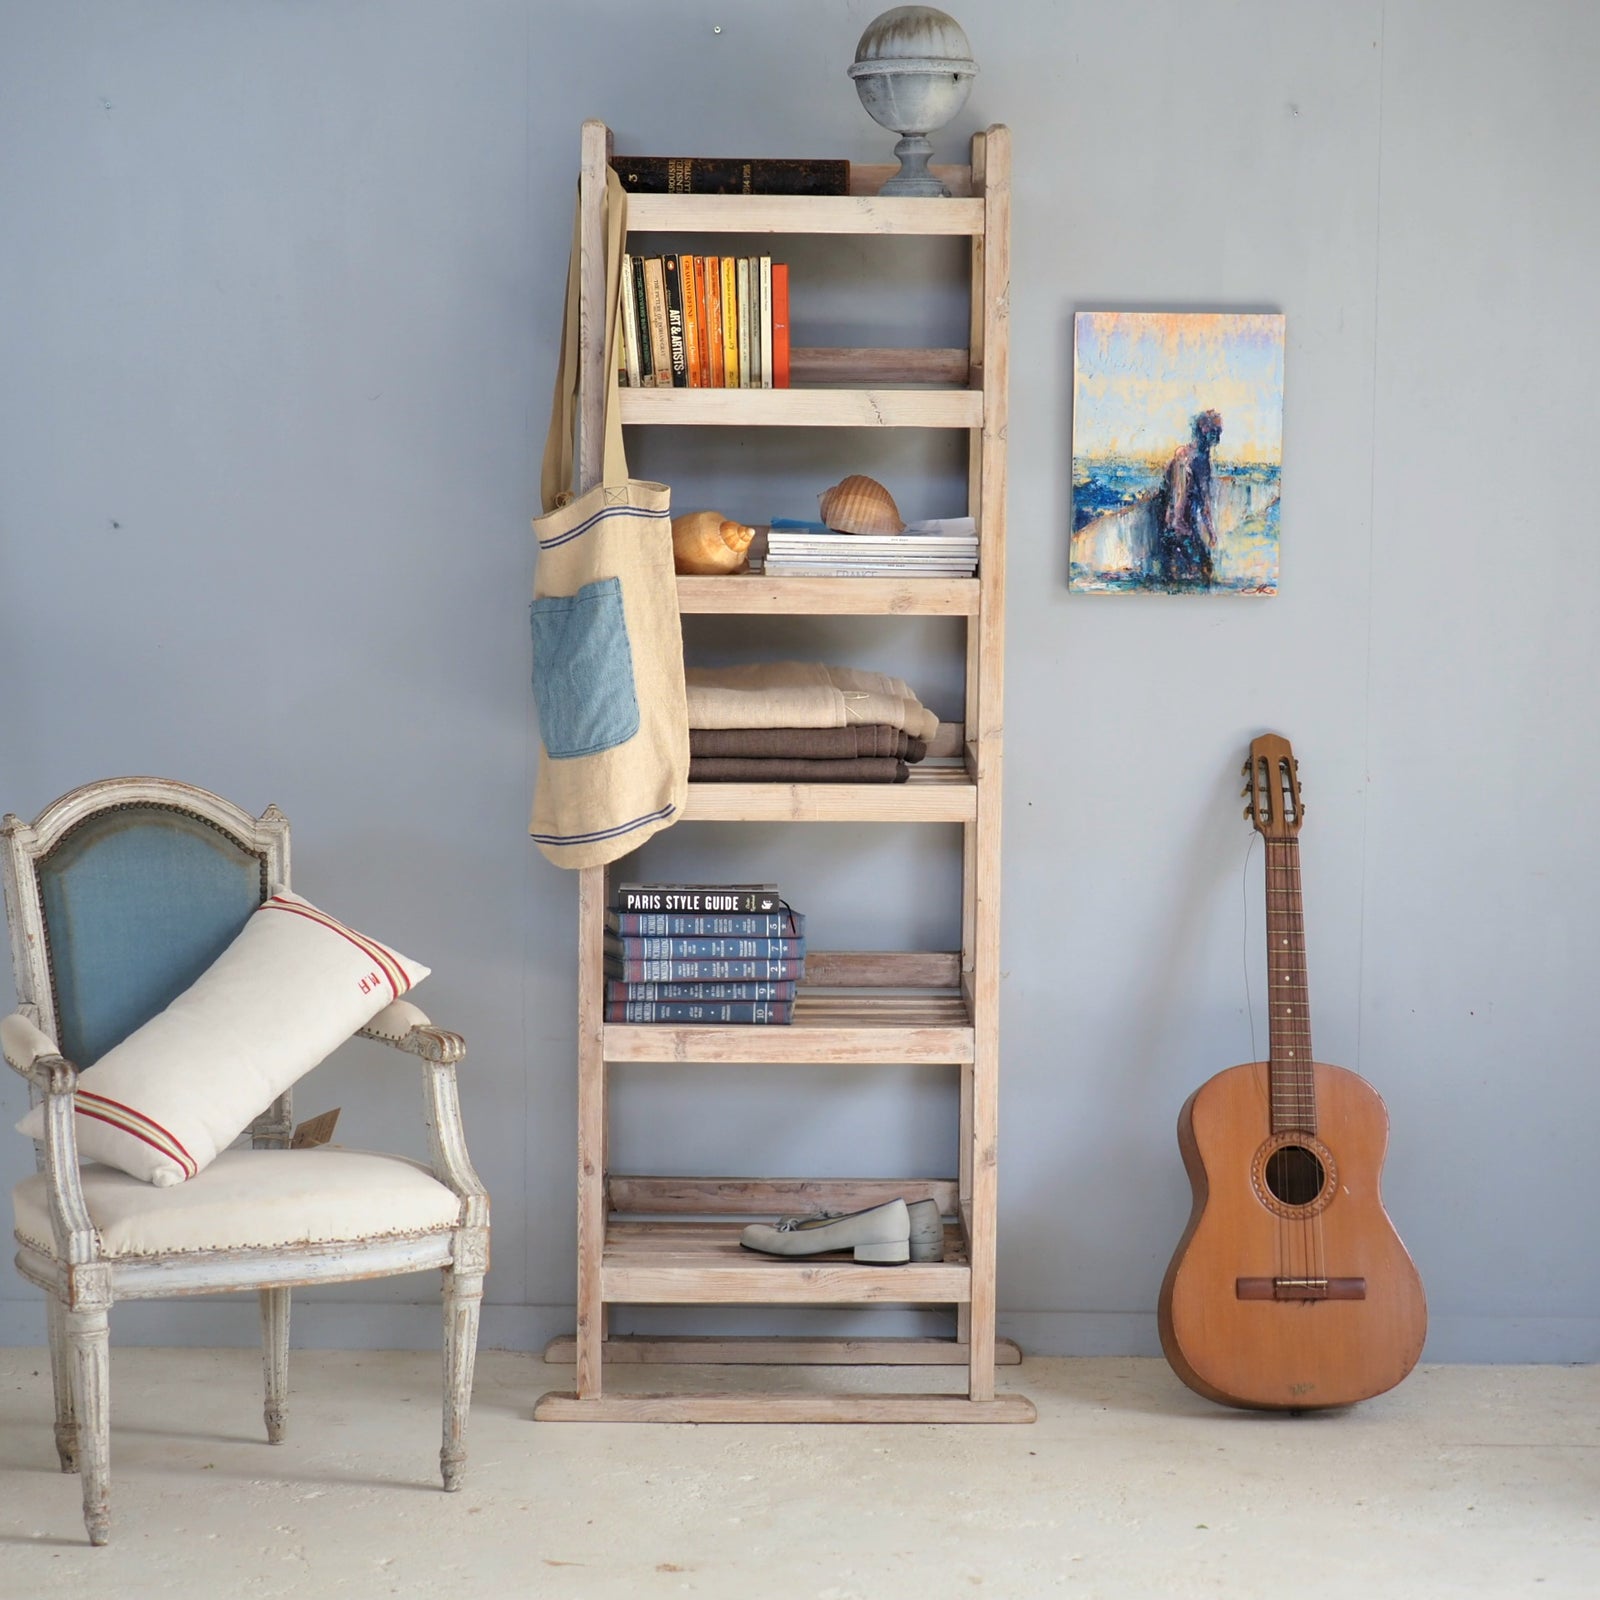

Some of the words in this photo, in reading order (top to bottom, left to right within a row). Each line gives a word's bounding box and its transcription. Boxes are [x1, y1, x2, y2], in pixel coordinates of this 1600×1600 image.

[628, 173, 638, 183] 3
[684, 260, 692, 291] GRAHAM
[669, 309, 680, 326] ART
[670, 326, 682, 335] &
[671, 335, 685, 371] ARTISTS
[627, 894, 661, 910] PARIS
[666, 894, 700, 911] STYLE
[705, 895, 739, 911] GUIDE
[756, 1009, 765, 1019] 10
